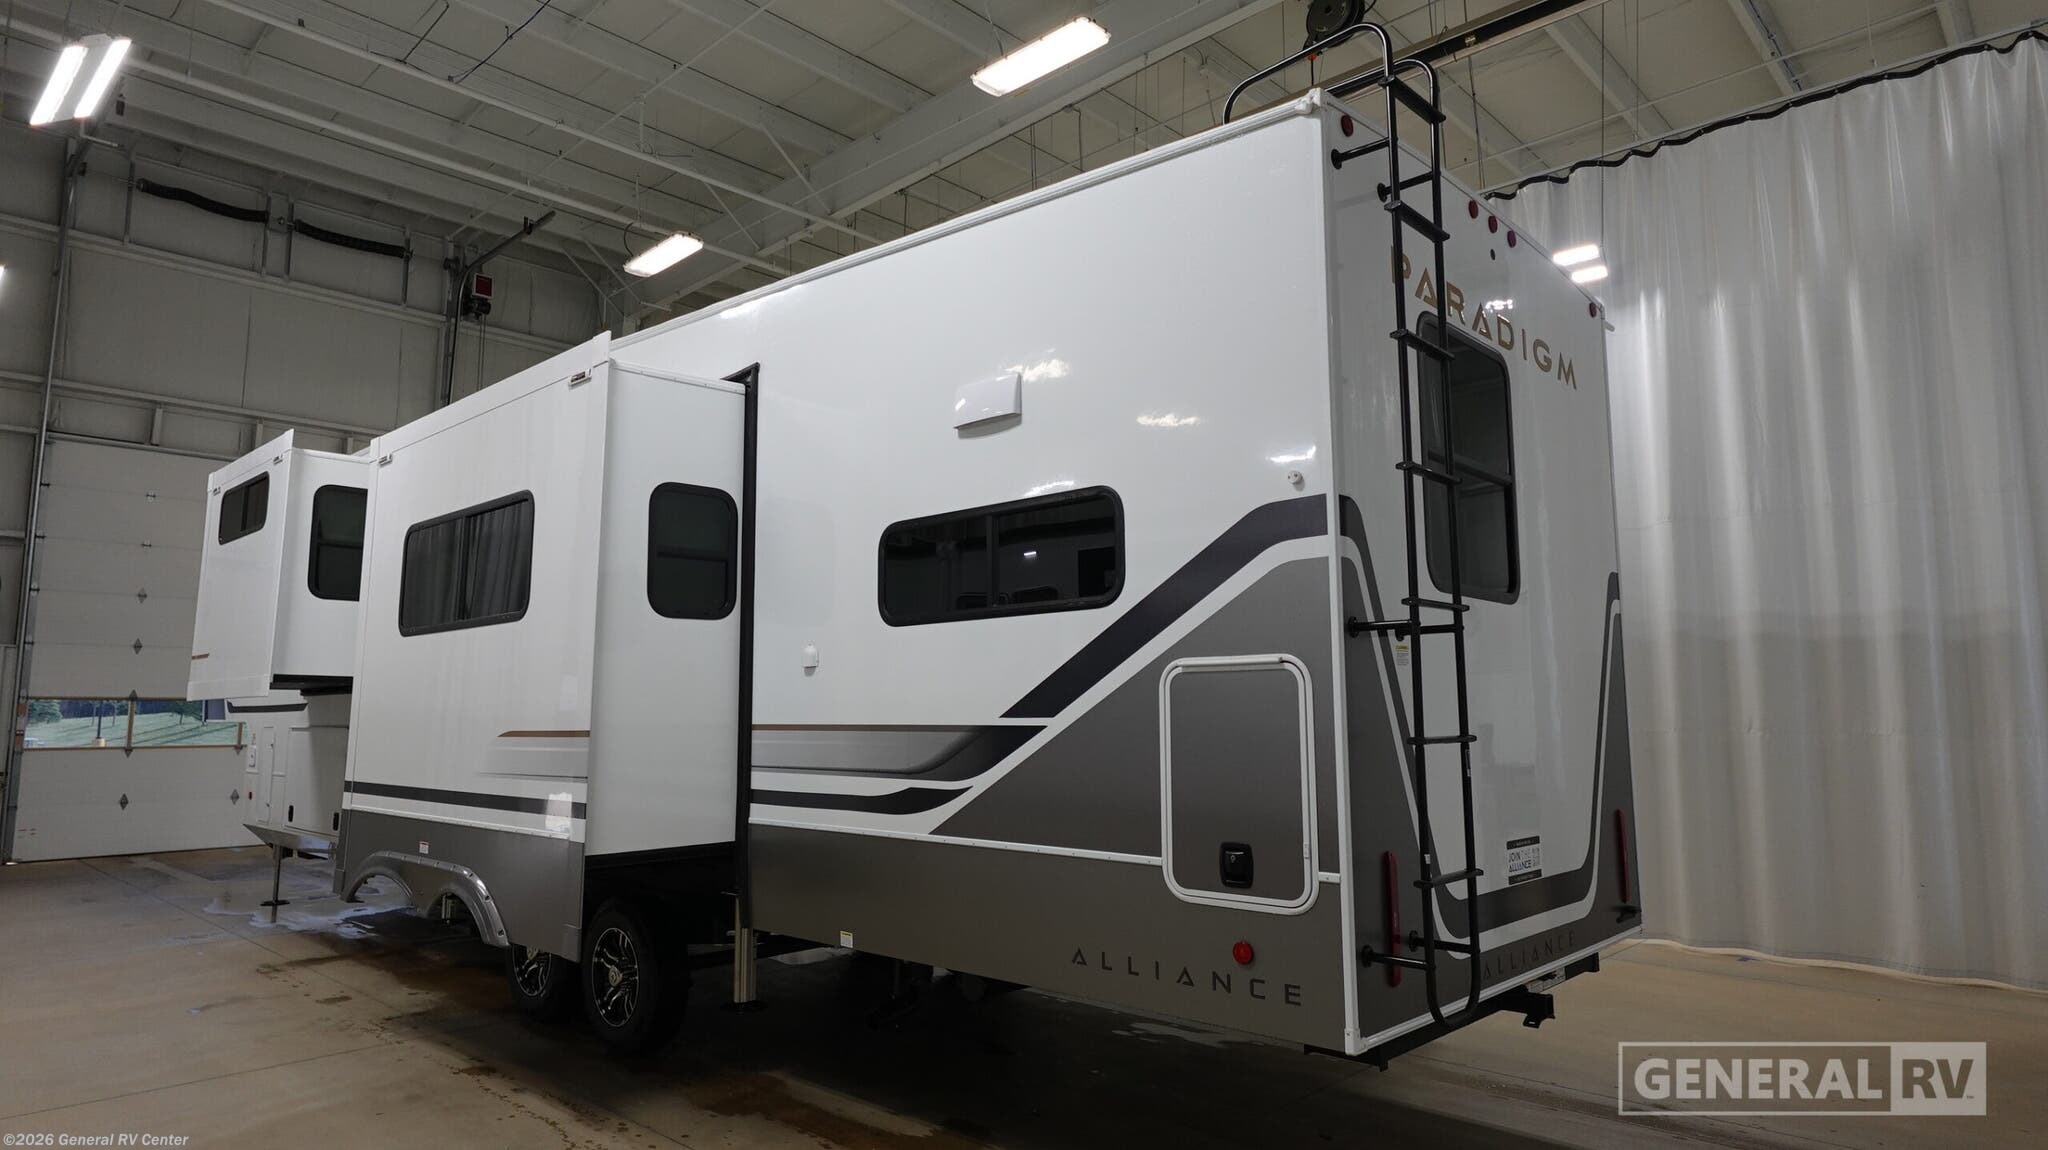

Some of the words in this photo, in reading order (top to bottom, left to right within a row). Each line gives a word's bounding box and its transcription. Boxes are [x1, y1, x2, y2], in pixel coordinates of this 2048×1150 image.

[1391, 246, 1577, 389] PARADIGM
[1072, 948, 1302, 1006] ALLIANCE
[1483, 930, 1576, 980] ALLIANCE
